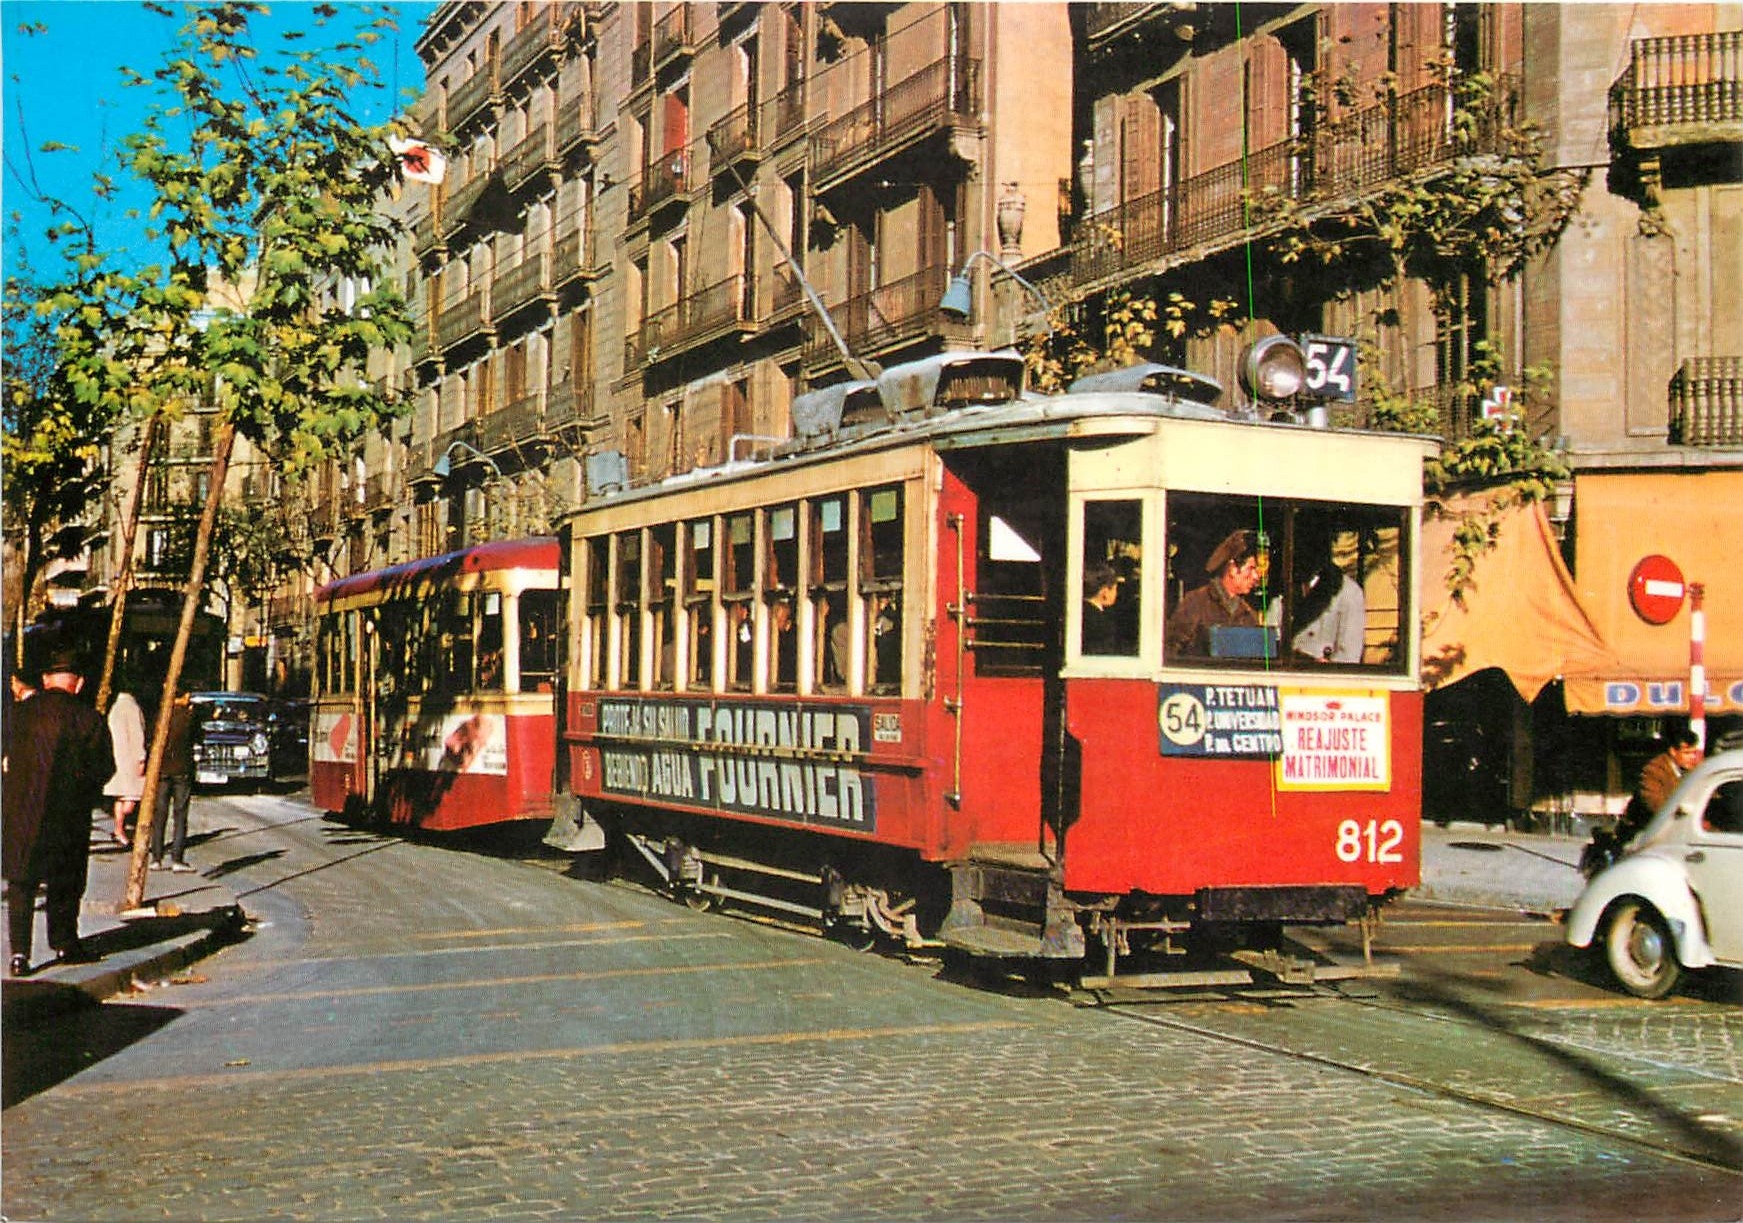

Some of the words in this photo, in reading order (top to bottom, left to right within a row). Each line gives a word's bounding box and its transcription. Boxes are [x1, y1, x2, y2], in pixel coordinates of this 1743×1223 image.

[1305, 343, 1351, 393] 54
[697, 706, 861, 760] FOURNIER
[1166, 702, 1202, 733] 54
[1297, 726, 1367, 751] REAJUSTE
[1340, 712, 1380, 722] PALACE
[652, 752, 694, 798] AGUA
[1284, 754, 1380, 779] MATRIMONIAL
[700, 757, 864, 822] FOURNIER
[1335, 819, 1403, 864] 812
